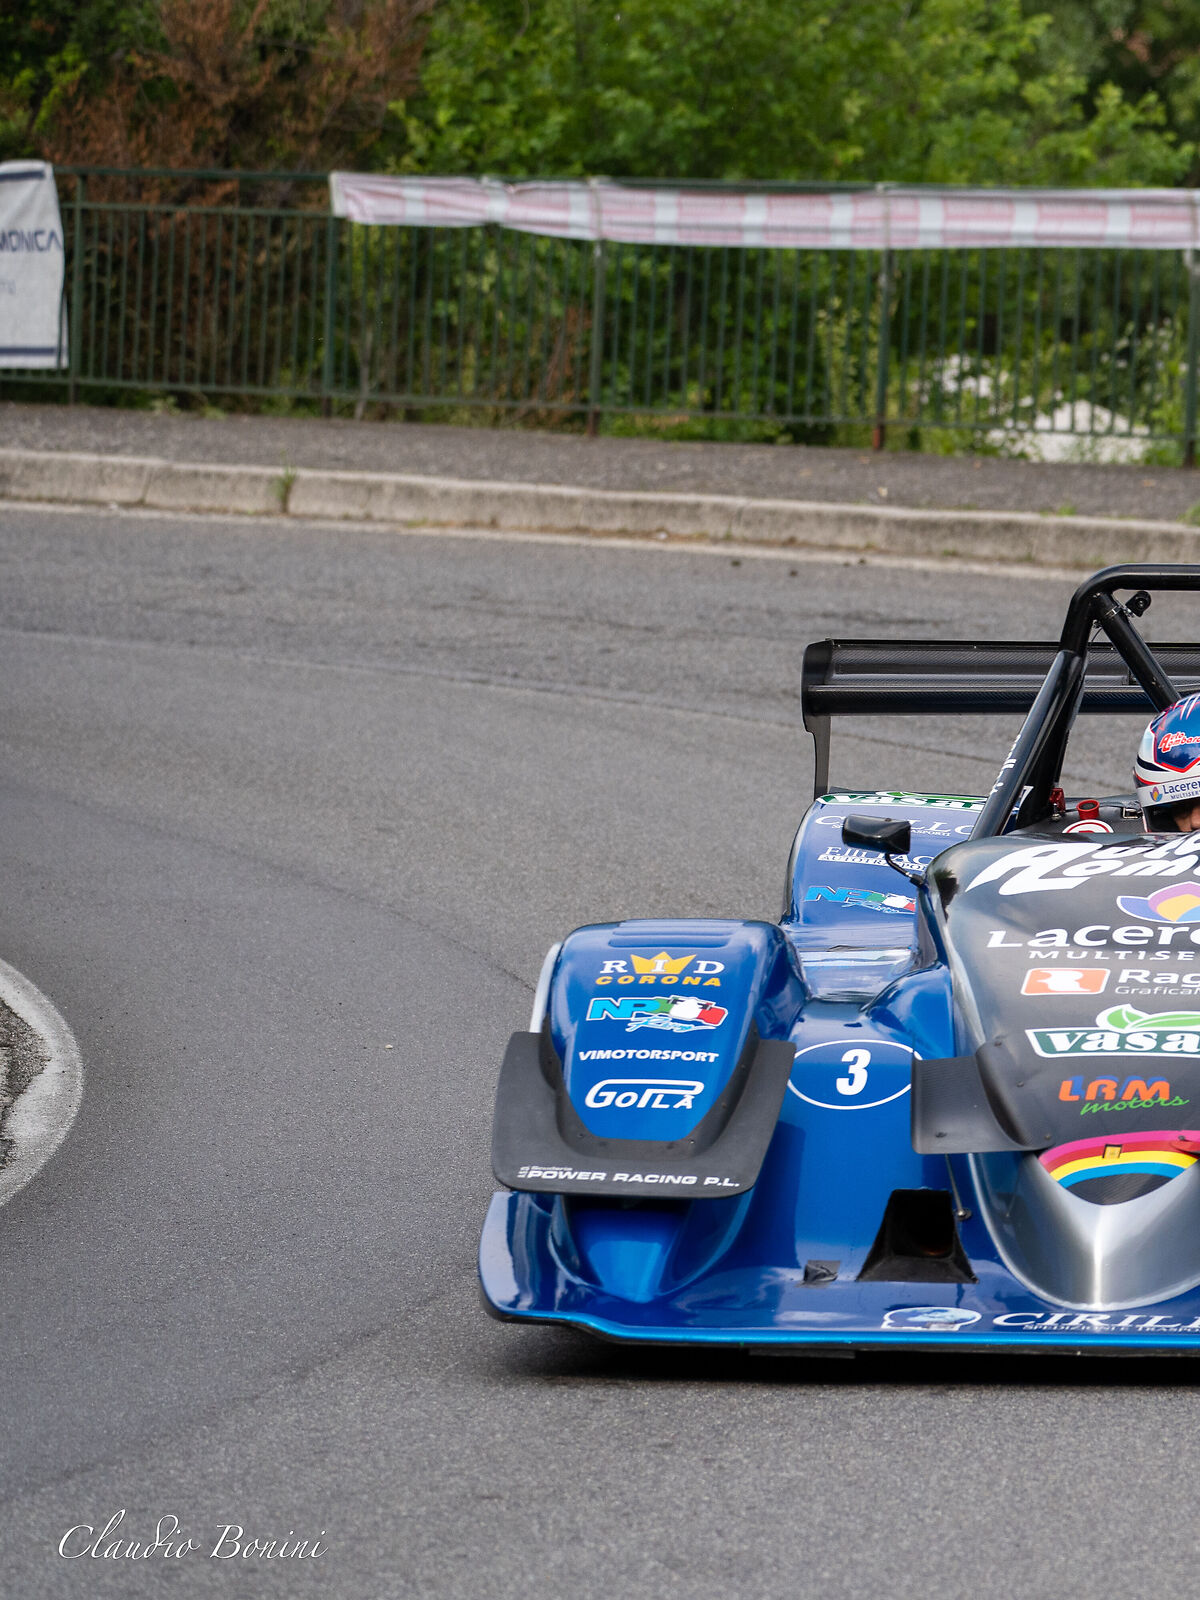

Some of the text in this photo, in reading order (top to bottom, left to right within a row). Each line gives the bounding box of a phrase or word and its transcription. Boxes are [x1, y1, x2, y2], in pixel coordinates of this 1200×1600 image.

[595, 975, 721, 987] CORONA
[578, 1049, 719, 1063] VIMOTORSPORT
[836, 1048, 870, 1096] 3
[1058, 1075, 1170, 1101] LRM
[1080, 1096, 1190, 1116] motors
[527, 1170, 607, 1181] POWER
[612, 1172, 698, 1185] RACING
[703, 1176, 740, 1187] P.L.
